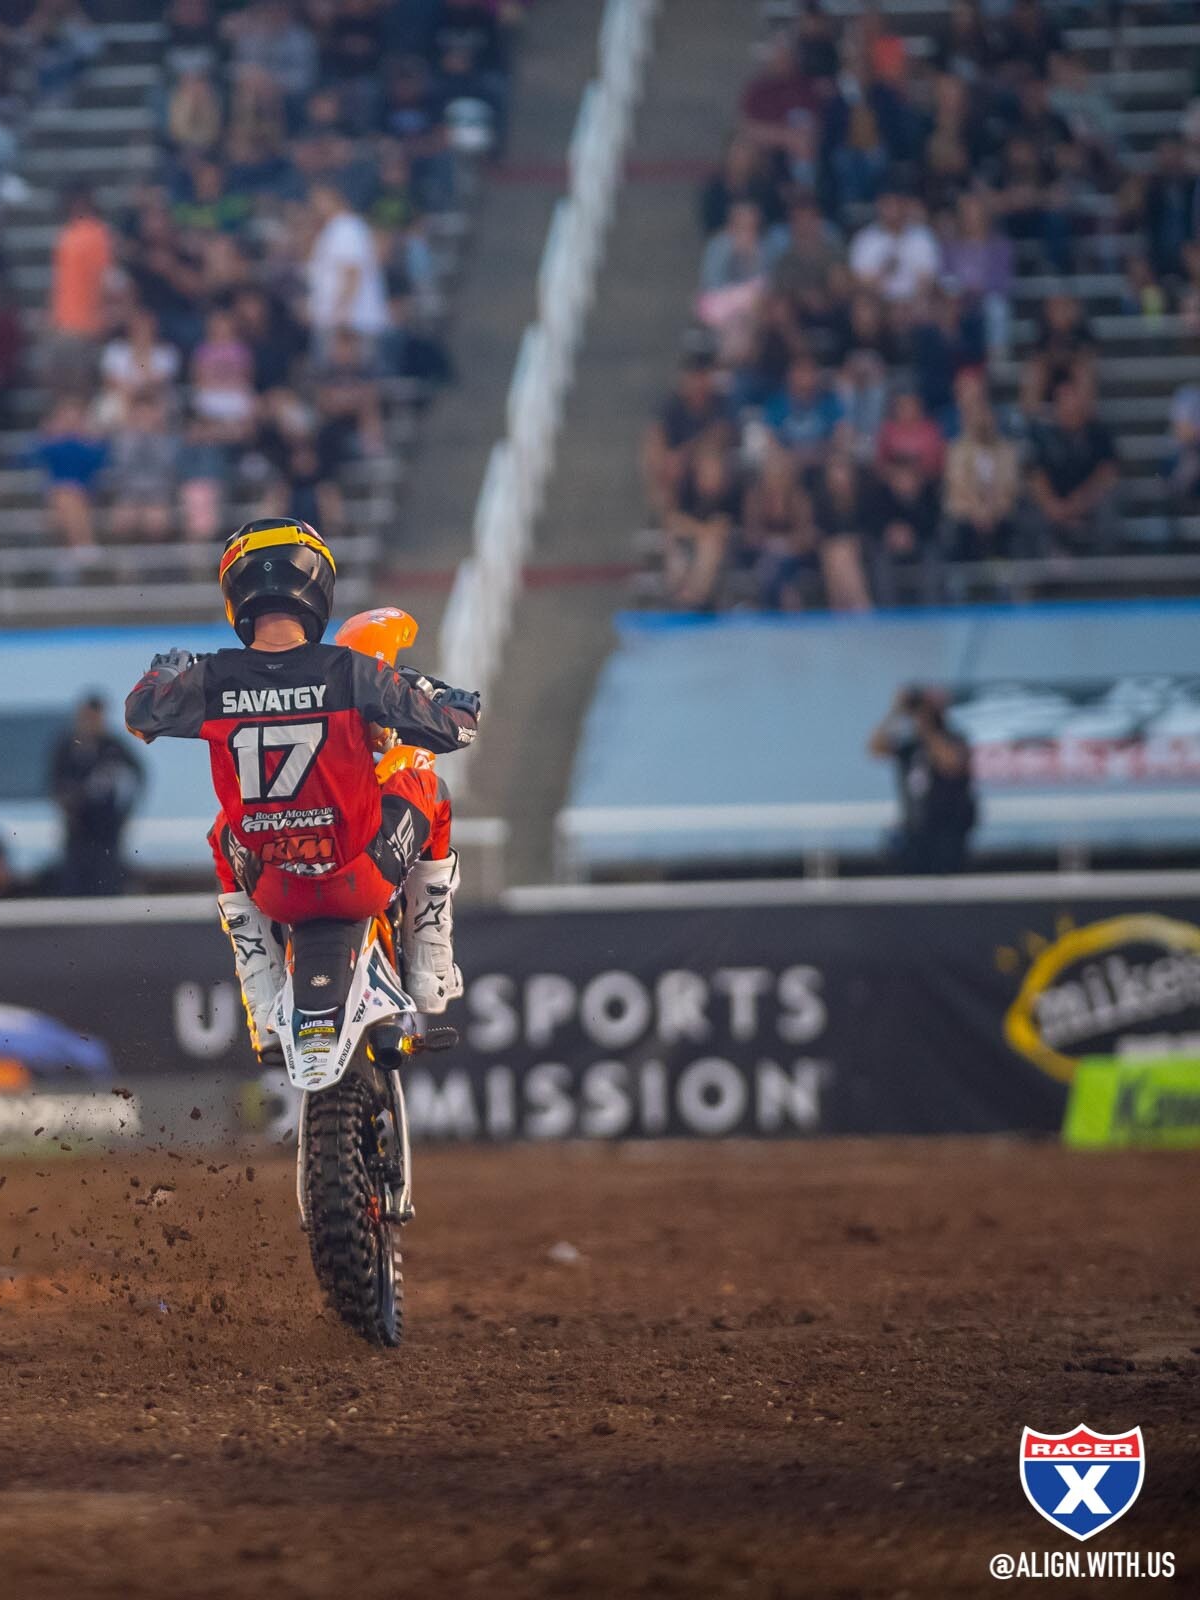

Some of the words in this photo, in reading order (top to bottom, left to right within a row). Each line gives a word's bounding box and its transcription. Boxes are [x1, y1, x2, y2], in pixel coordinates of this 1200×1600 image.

[222, 685, 326, 713] SAVATGY
[231, 720, 325, 800] 17
[255, 811, 282, 820] ROCKY
[285, 807, 333, 818] MOUNTAIN
[261, 834, 334, 861] KTM
[462, 966, 830, 1053] SPORTS
[338, 1037, 352, 1068] DUNLOP
